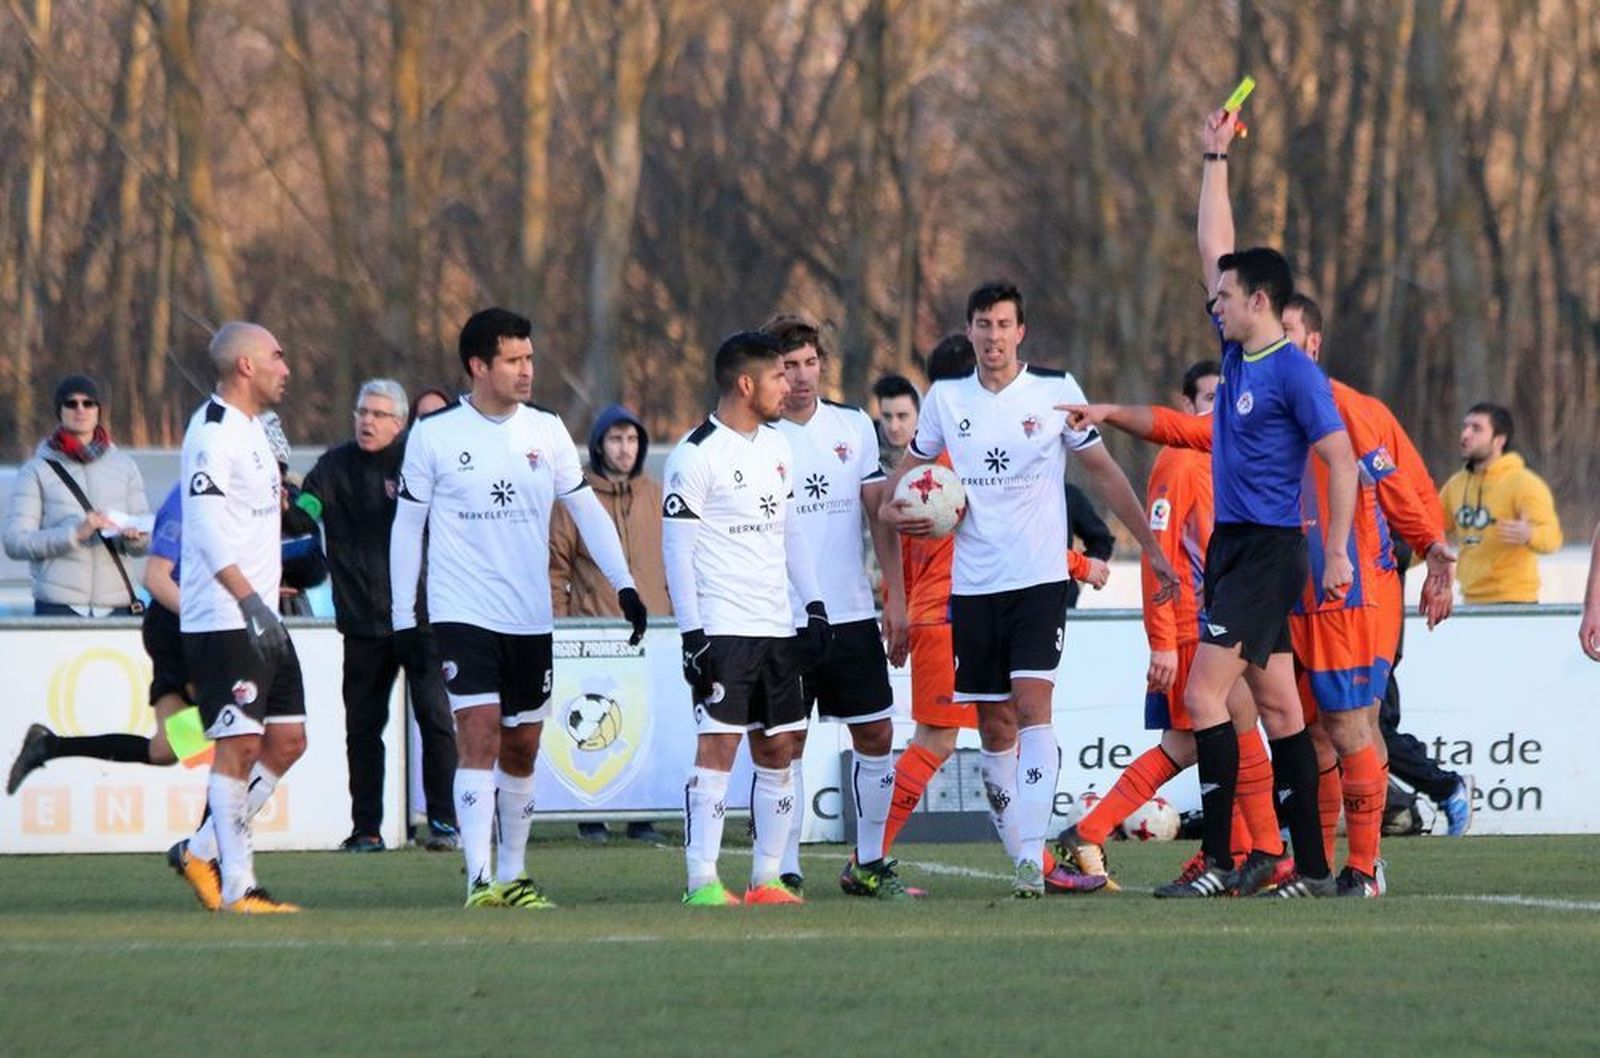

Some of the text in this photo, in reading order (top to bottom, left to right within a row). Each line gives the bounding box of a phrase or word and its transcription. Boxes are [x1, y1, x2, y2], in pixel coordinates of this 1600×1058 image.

[1079, 737, 1132, 769] de
[1490, 732, 1542, 764] de
[1472, 779, 1543, 811] eón
